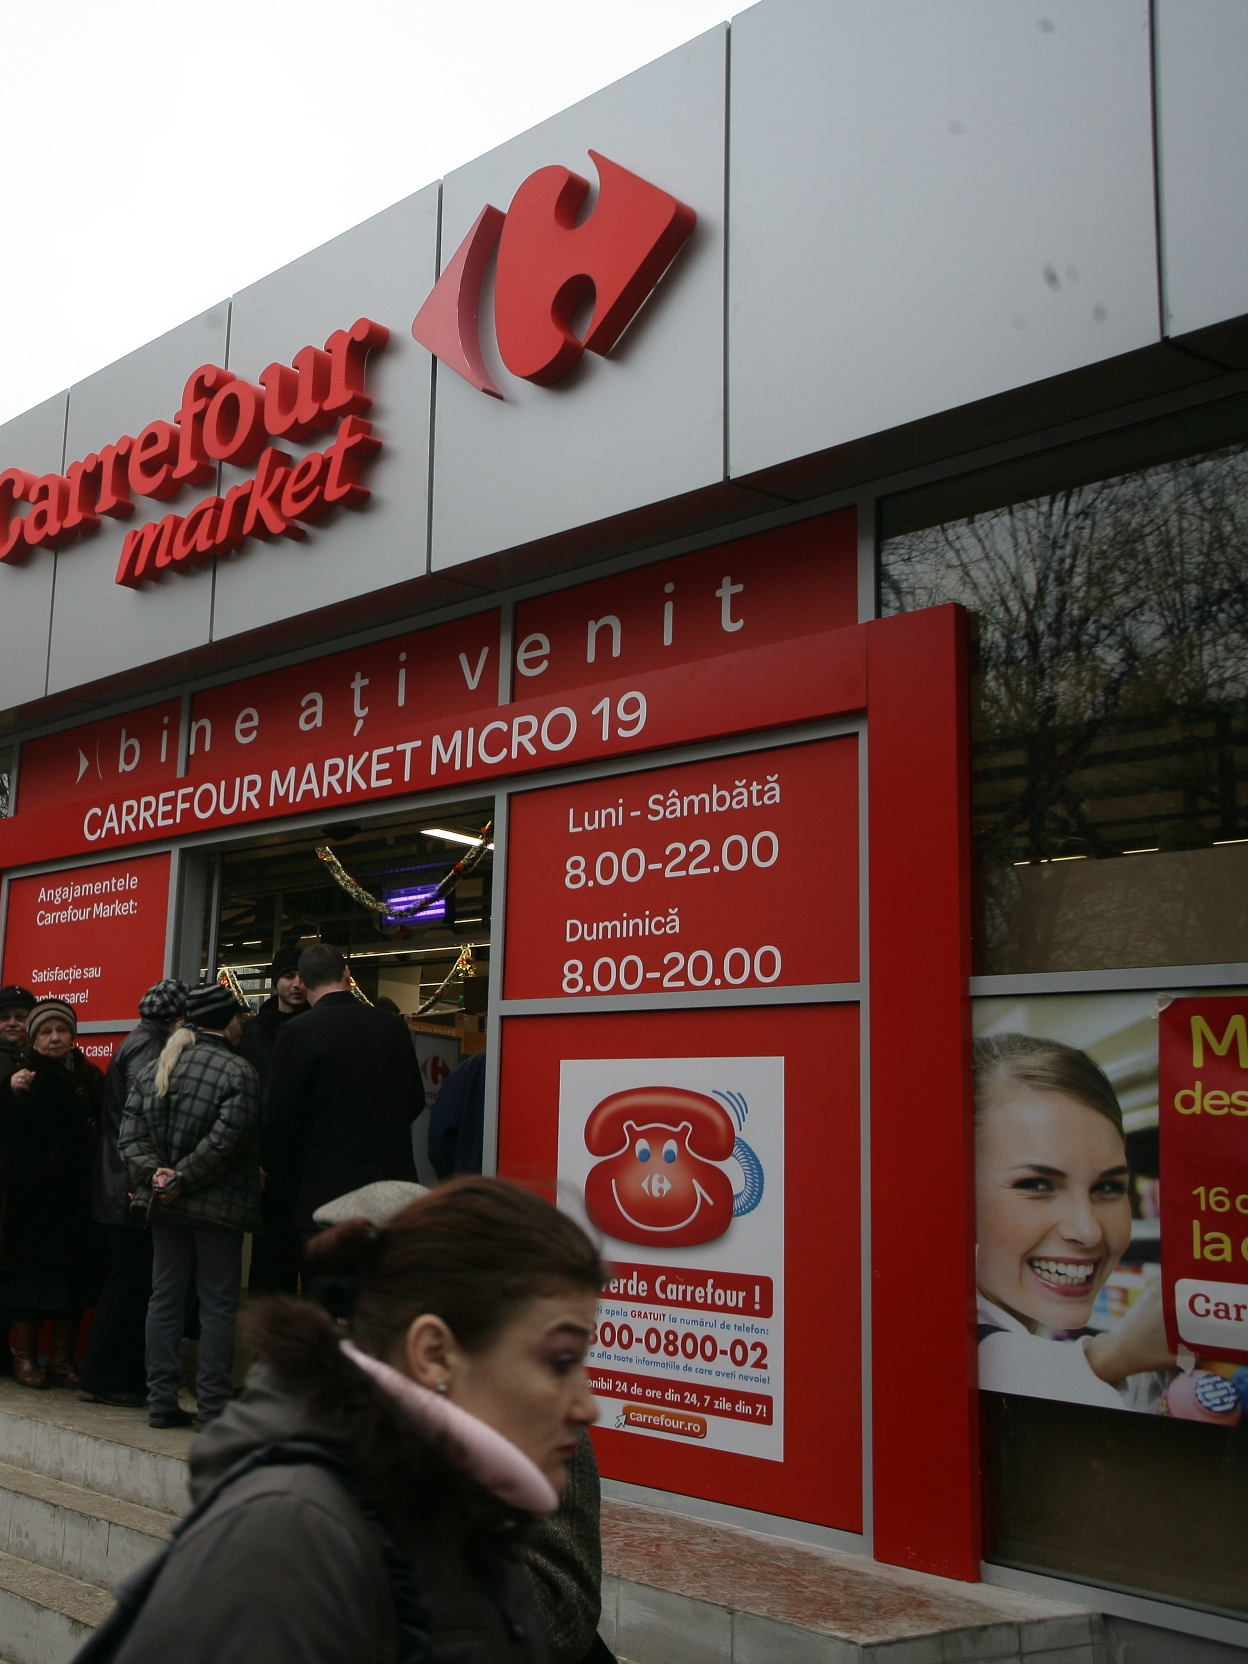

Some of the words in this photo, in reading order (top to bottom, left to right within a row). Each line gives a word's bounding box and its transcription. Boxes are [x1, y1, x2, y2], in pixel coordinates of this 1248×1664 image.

[115, 415, 382, 590] market
[118, 705, 260, 773] bine
[459, 575, 745, 691] venit
[82, 773, 262, 842] CARREFOUR
[268, 740, 423, 807] MARKET
[430, 706, 578, 775] MICRO
[591, 690, 647, 742] 19
[568, 798, 624, 833] Luni
[647, 773, 781, 821] Sâmbătă
[564, 830, 780, 889] 8.00-22.00
[37, 873, 138, 904] Angajamentele
[36, 906, 91, 926] Carrefour
[93, 899, 138, 918] Market:
[565, 907, 680, 943] Duminică
[31, 965, 82, 984] Satisfacție
[83, 966, 102, 979] sau
[561, 945, 782, 993] 8.00-20.00
[85, 1042, 113, 1057] case!
[1174, 1080, 1248, 1117] des
[1192, 1186, 1231, 1213] 16
[1192, 1219, 1232, 1263] la
[654, 1275, 746, 1308] Carrefour
[1188, 1292, 1248, 1322] Car
[605, 1308, 628, 1318] apela
[630, 1310, 666, 1322] GRATUIT
[668, 1314, 677, 1323] la
[679, 1317, 717, 1328] numărul
[719, 1320, 731, 1331] de
[733, 1322, 769, 1335] telefon:
[597, 1351, 611, 1360] afla
[613, 1354, 633, 1363] toate
[682, 1363, 693, 1372] de
[695, 1367, 712, 1375] care
[738, 1374, 770, 1385] nevoie!
[615, 1381, 628, 1393] 24
[630, 1383, 643, 1396] de
[645, 1389, 662, 1398] ore
[664, 1389, 681, 1402] din
[684, 1392, 701, 1407] 24,
[704, 1396, 711, 1407] 7
[714, 1397, 732, 1411] zile
[735, 1401, 752, 1414] din
[755, 1404, 767, 1417] 7!
[629, 1410, 701, 1433] carrefour.ro
